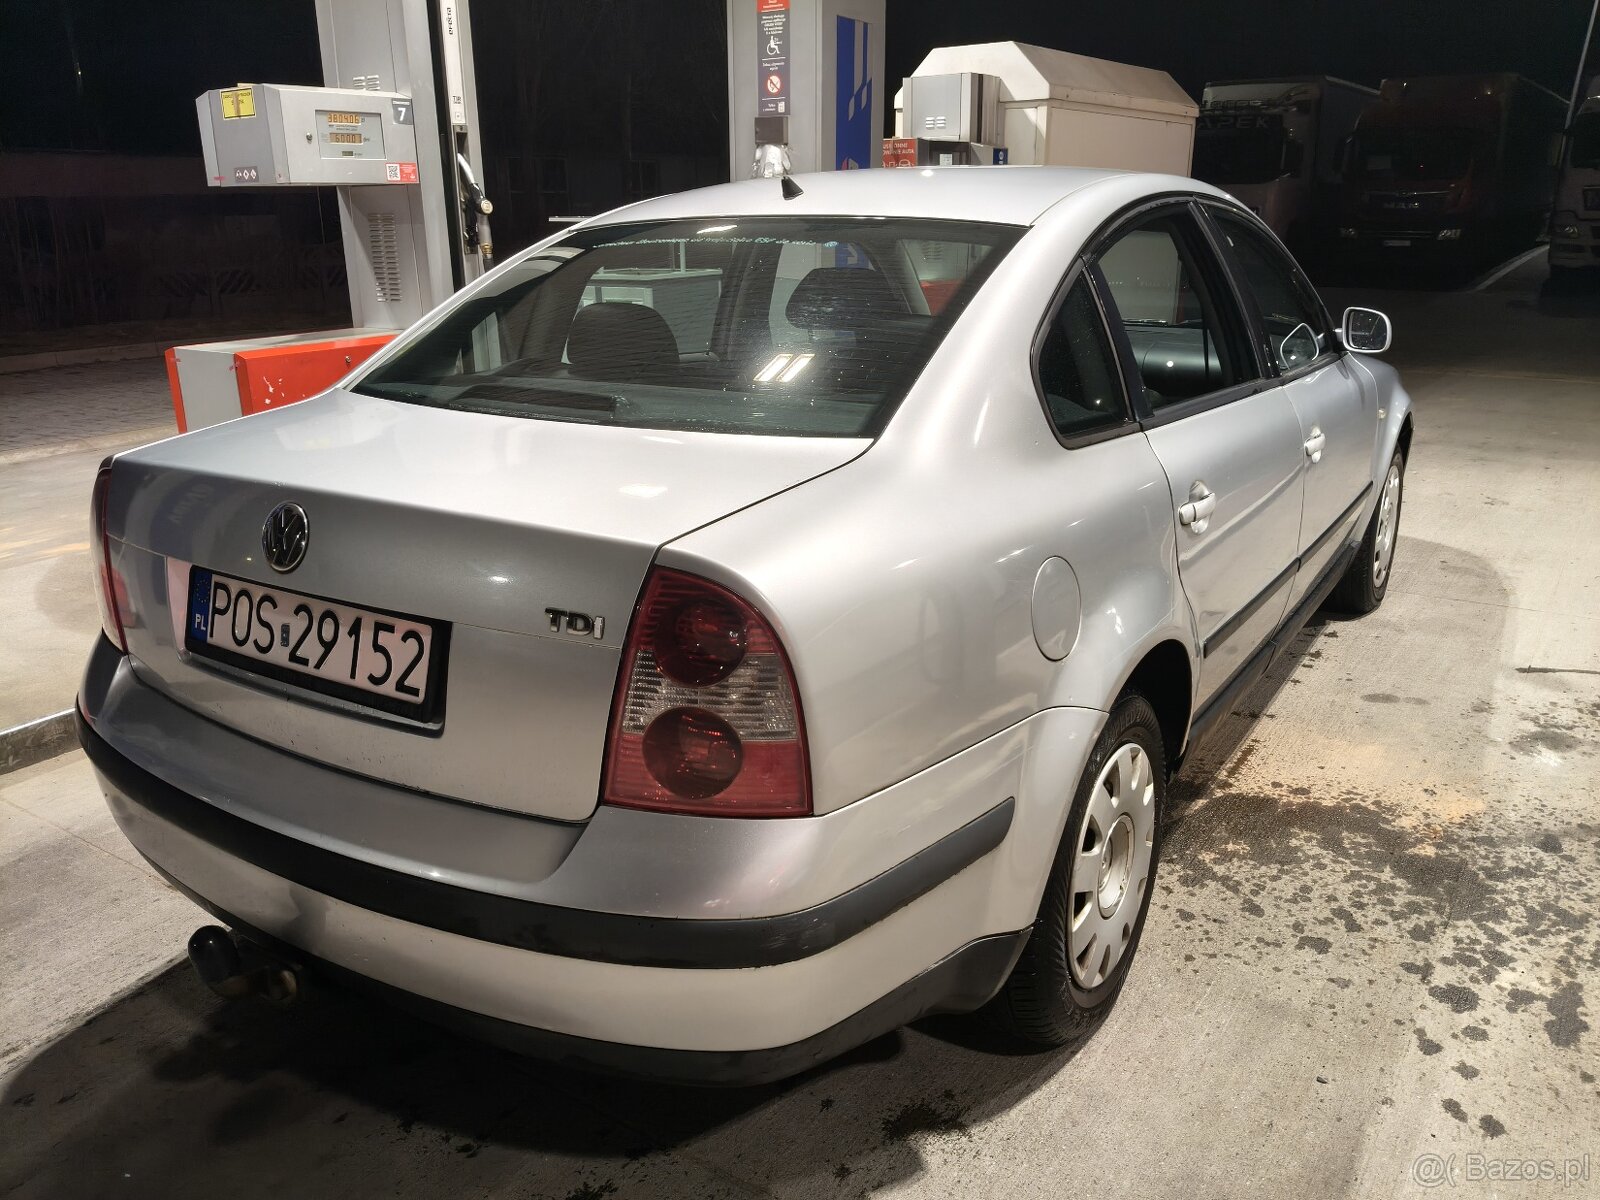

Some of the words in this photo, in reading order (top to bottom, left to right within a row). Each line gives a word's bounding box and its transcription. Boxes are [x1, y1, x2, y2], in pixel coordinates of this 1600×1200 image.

[397, 107, 406, 121] 7
[195, 613, 206, 631] PL
[544, 607, 605, 640] TDI
[209, 581, 278, 654] POS
[288, 604, 425, 698] 29152
